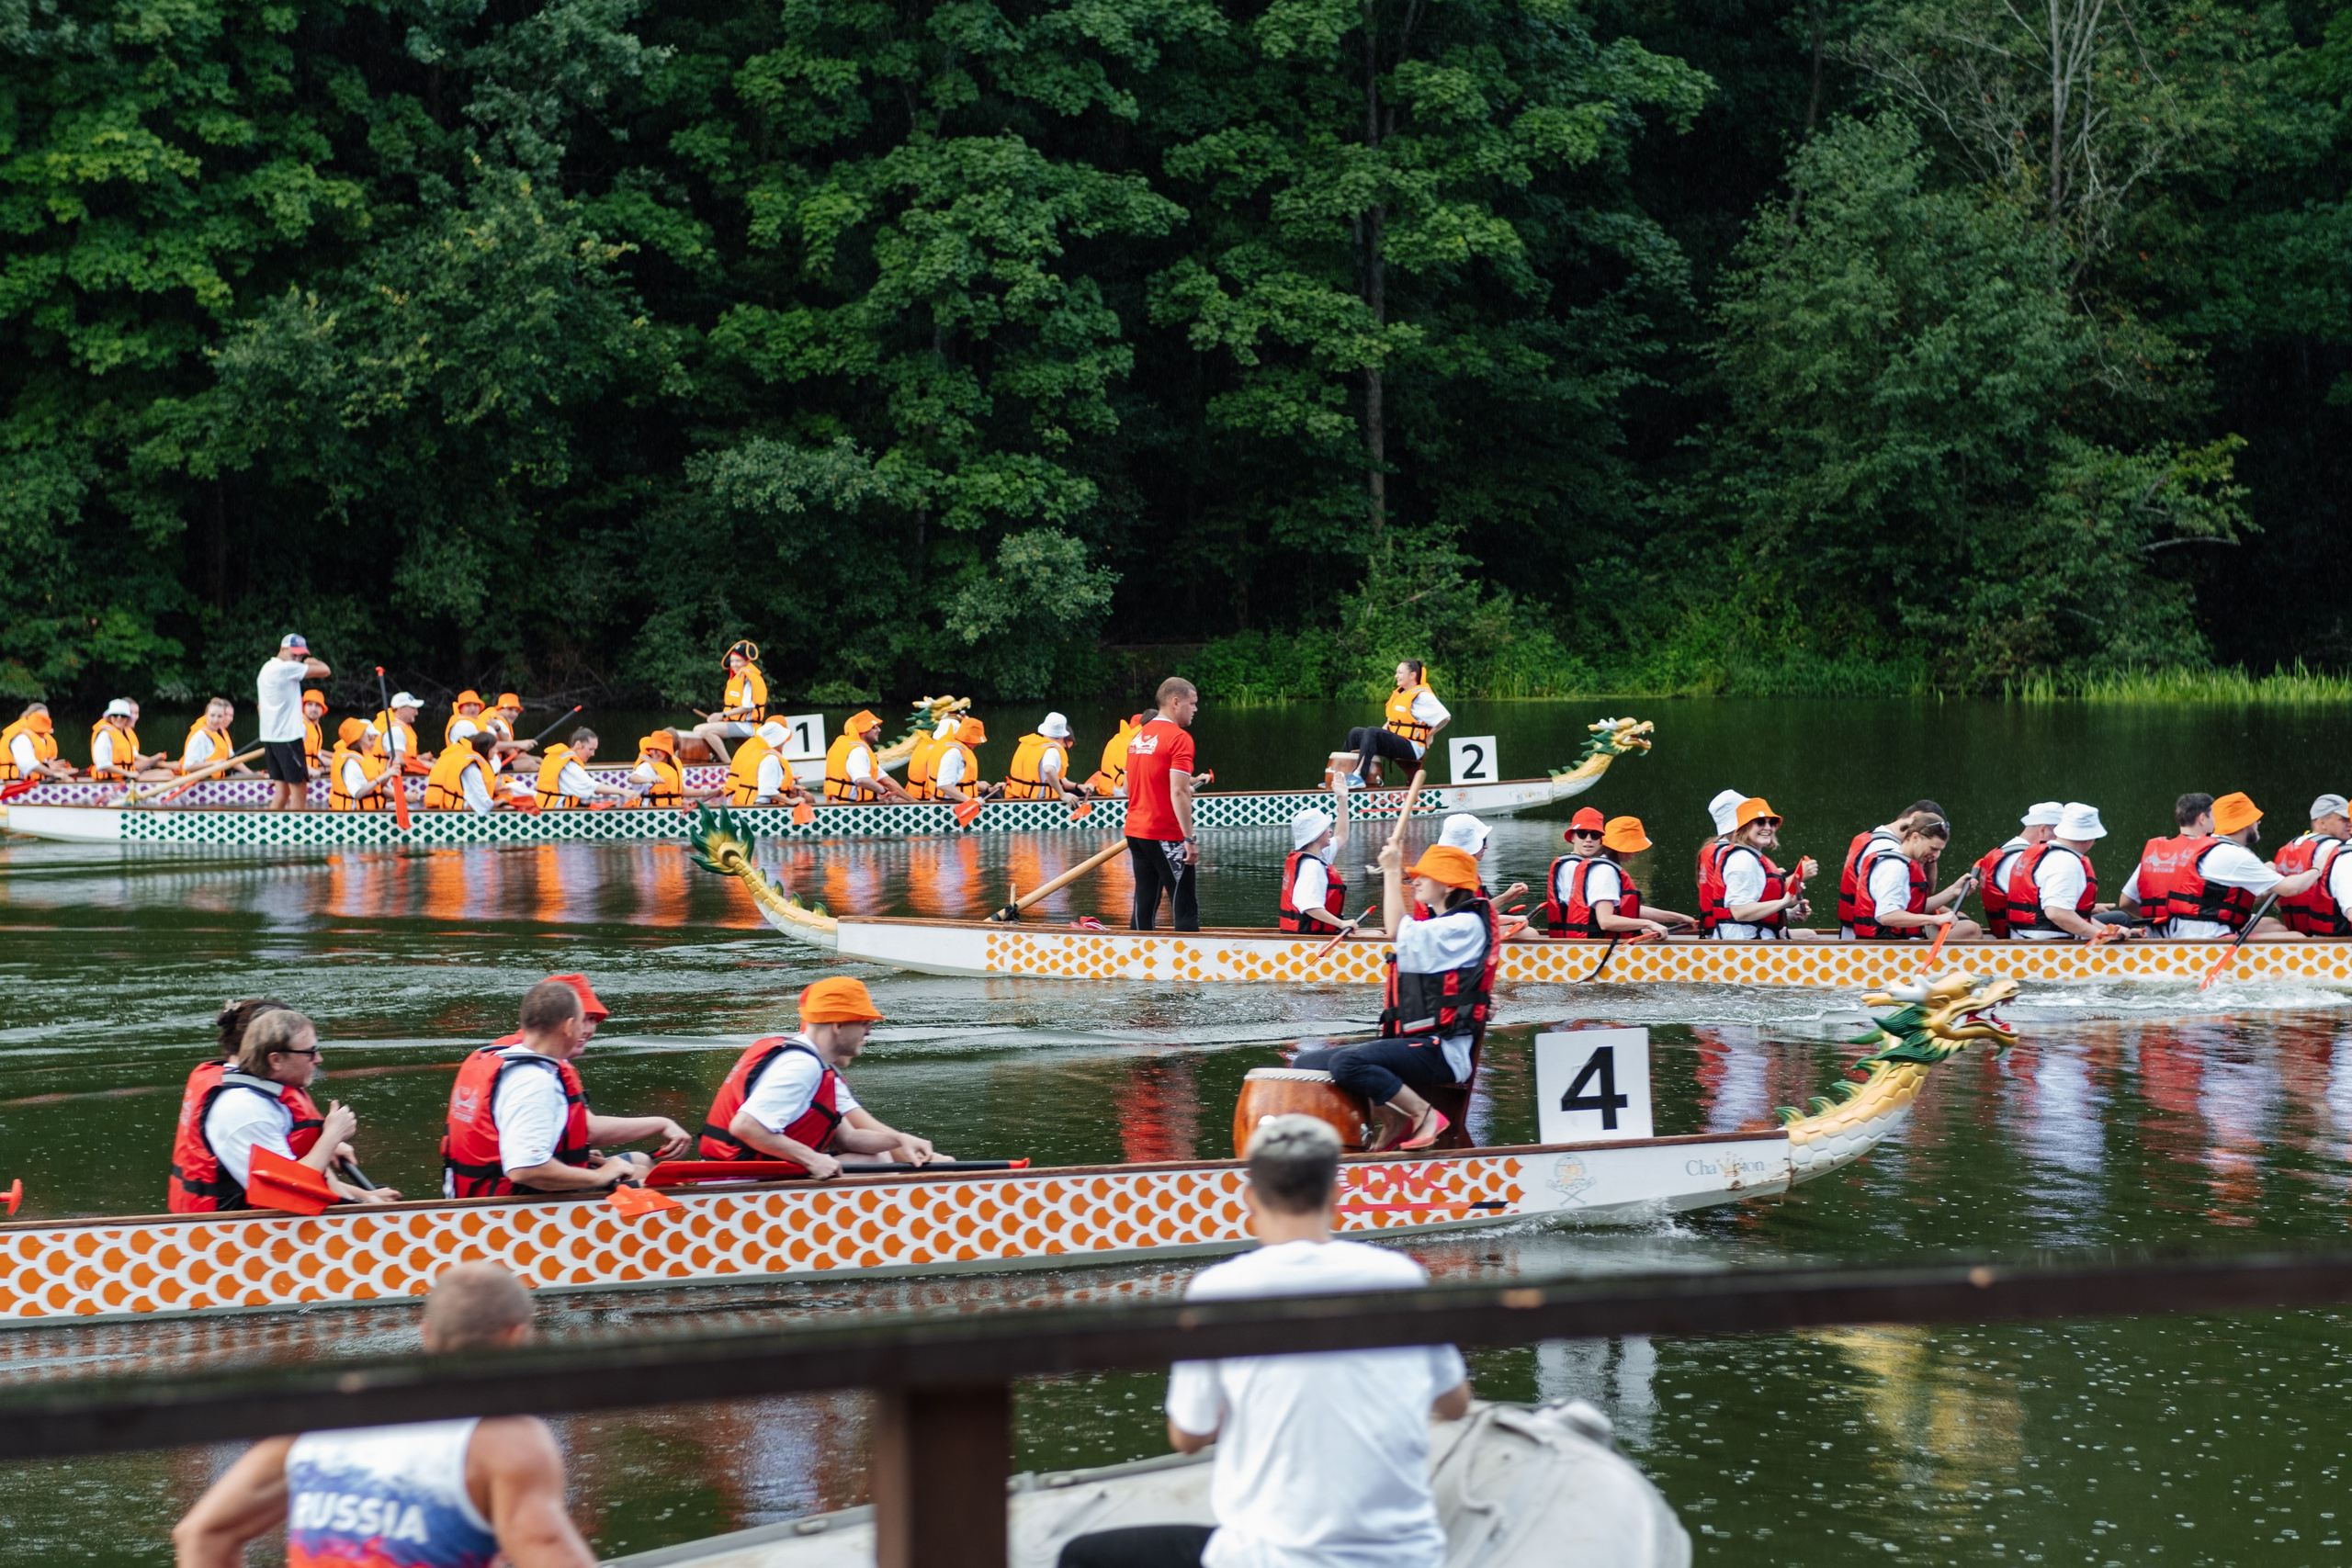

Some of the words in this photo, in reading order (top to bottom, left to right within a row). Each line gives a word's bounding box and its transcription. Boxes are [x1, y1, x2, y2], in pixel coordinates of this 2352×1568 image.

[796, 721, 809, 752] 1
[1462, 743, 1486, 779] 2
[1560, 1045, 1628, 1130] 4
[289, 1491, 430, 1544] RUSSIA
